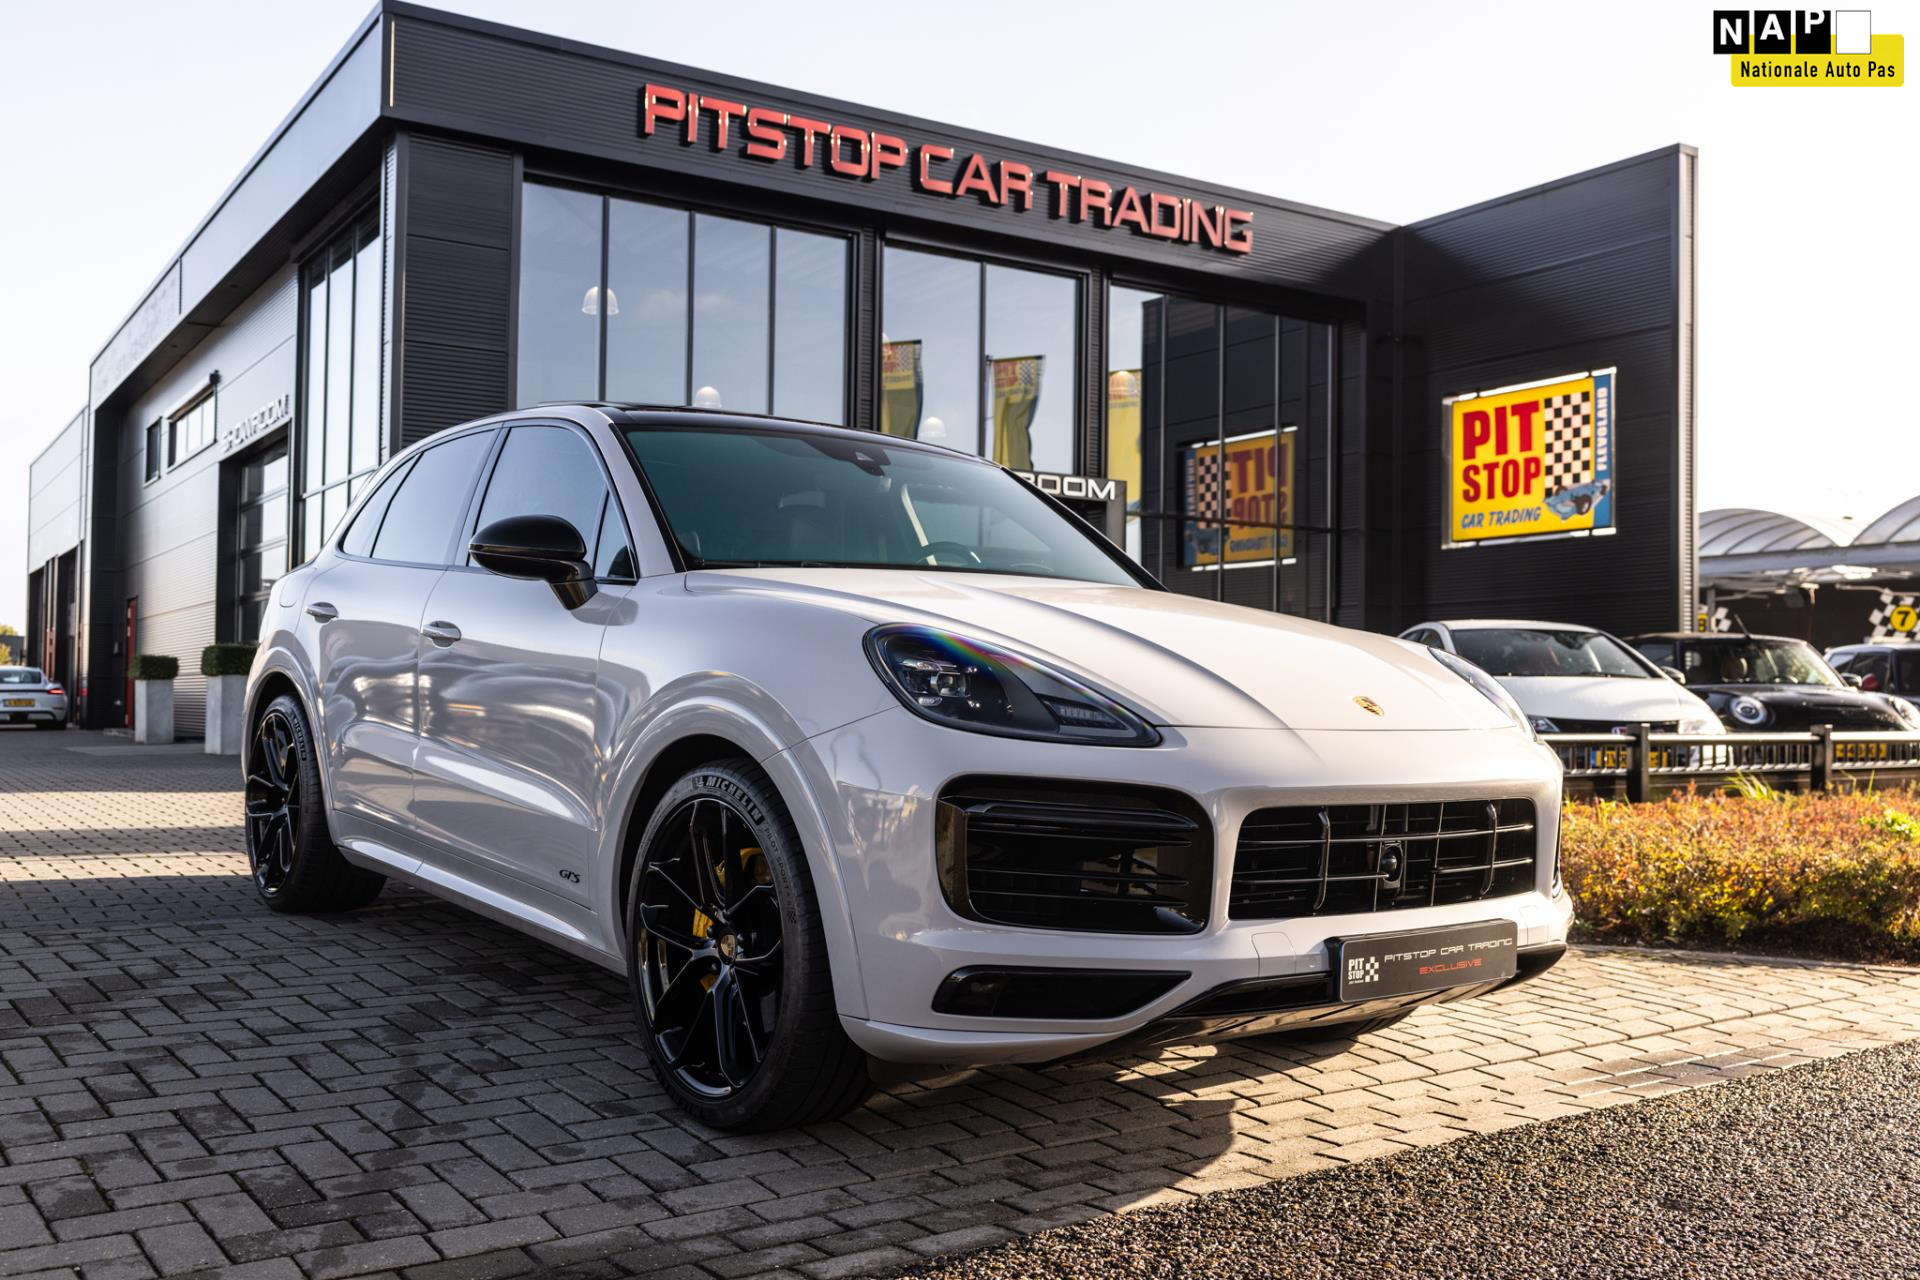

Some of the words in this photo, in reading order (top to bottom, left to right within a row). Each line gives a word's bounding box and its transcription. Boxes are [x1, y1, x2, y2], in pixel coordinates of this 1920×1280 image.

[643, 83, 908, 180] PITSTOP
[920, 144, 1034, 211] CAR
[1047, 170, 1254, 254] TRADING
[1463, 400, 1540, 460] PIT
[1462, 456, 1541, 503] STOP
[1461, 512, 1484, 529] CAR
[1488, 507, 1542, 526] TRADING
[1897, 611, 1910, 627] 7
[706, 776, 762, 822] MICHELIN
[559, 870, 581, 883] GTS
[1384, 949, 1437, 963] PITSTOP
[1440, 945, 1464, 956] CAR
[1468, 938, 1512, 951] TRADING
[1348, 957, 1364, 971] PIT
[1348, 970, 1364, 980] STOP
[1419, 958, 1482, 975] EXCLUSIVE
